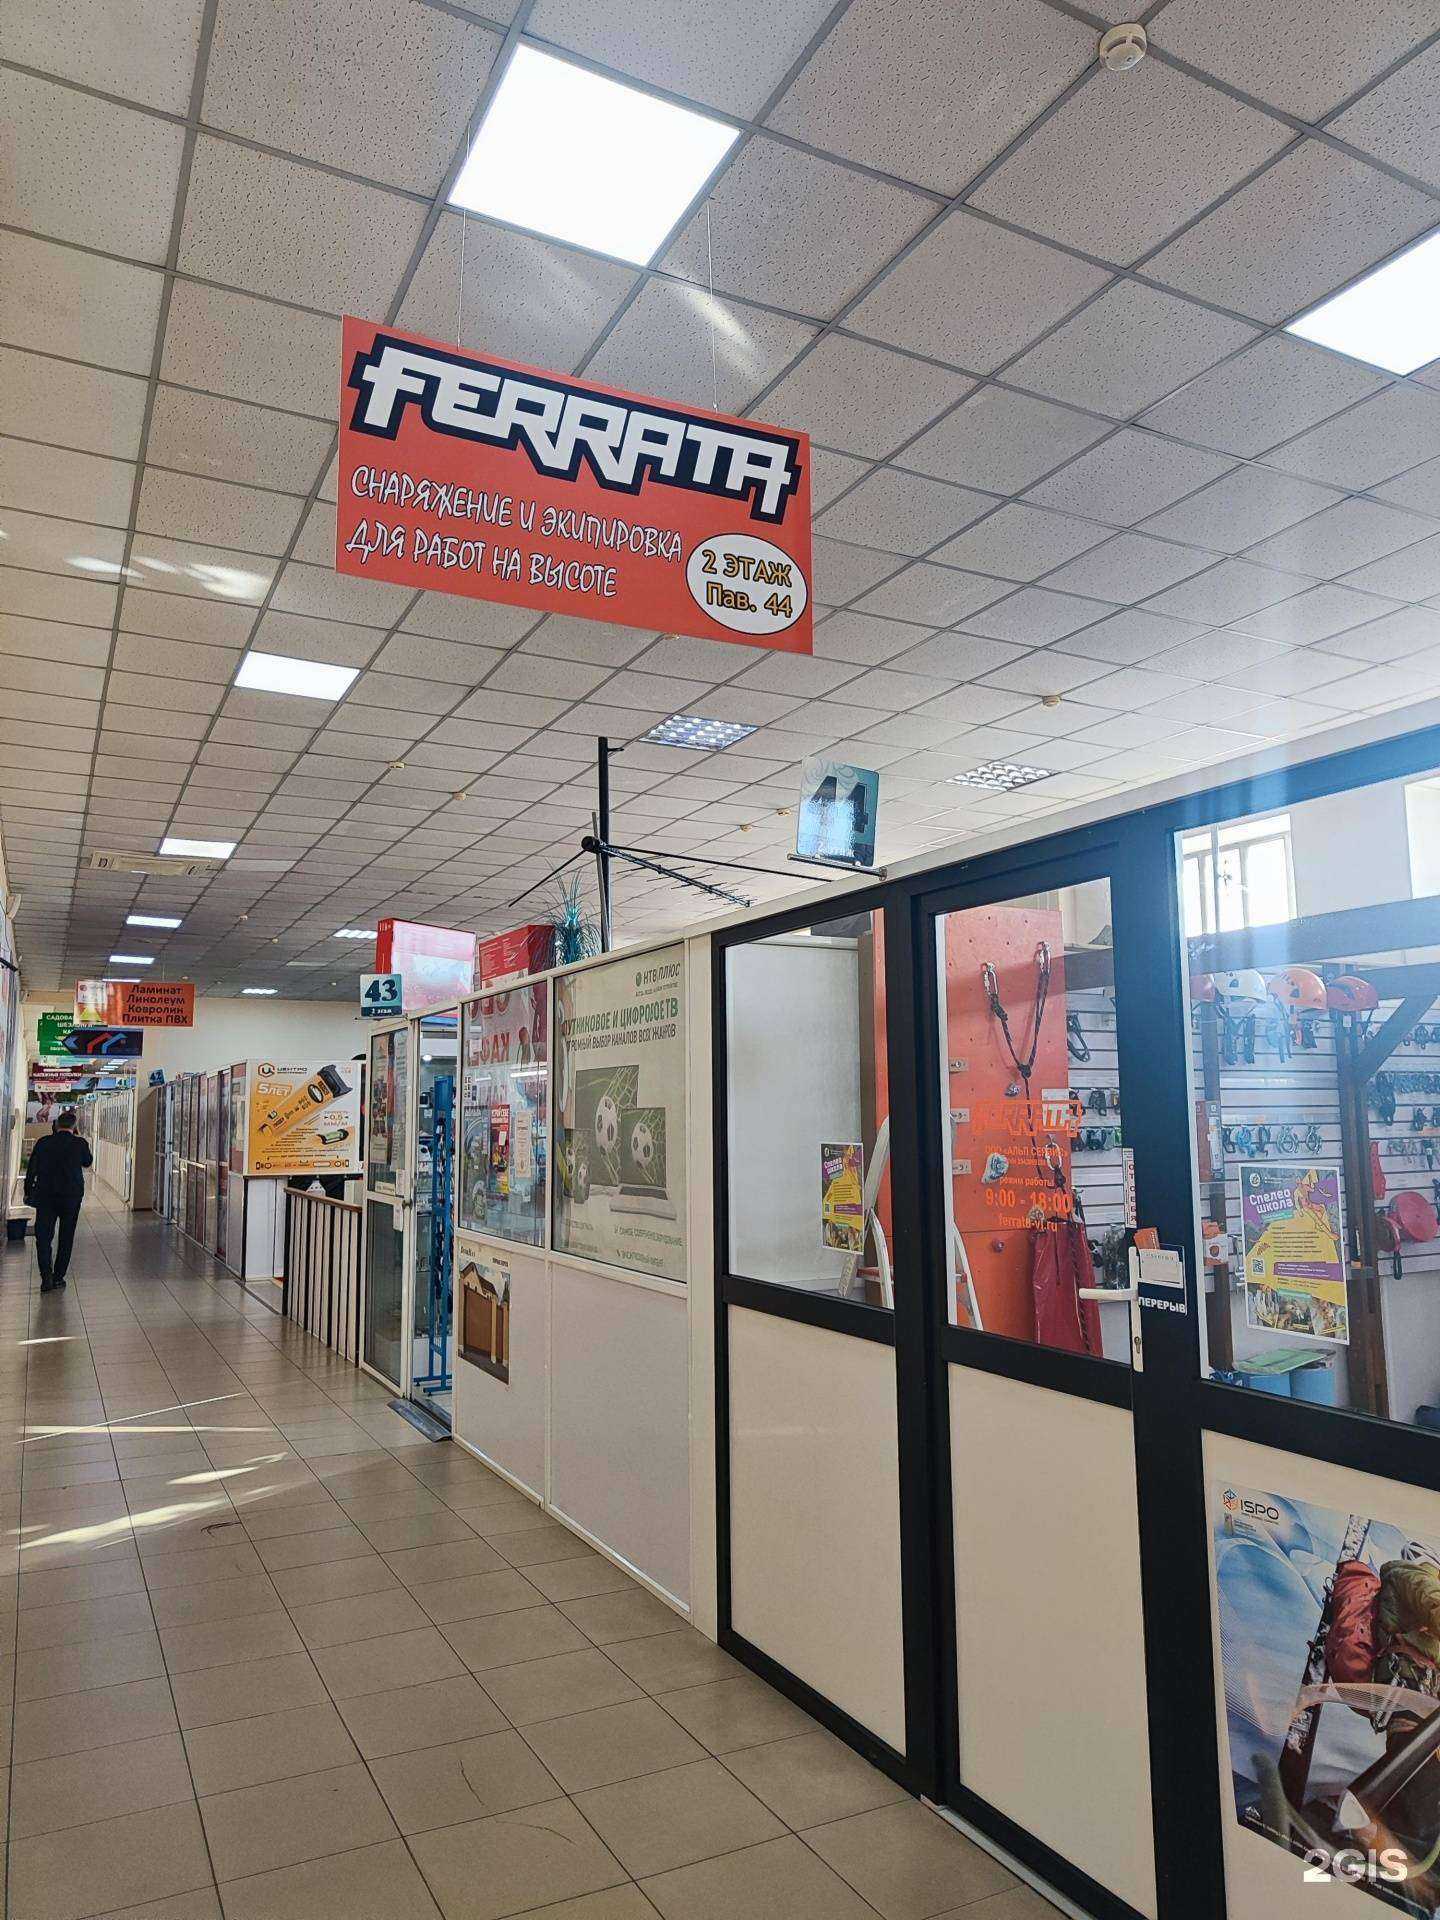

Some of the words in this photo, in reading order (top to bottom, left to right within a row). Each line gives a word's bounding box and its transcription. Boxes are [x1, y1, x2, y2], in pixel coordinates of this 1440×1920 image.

[349, 335, 801, 524] FERRATA
[351, 465, 513, 528] СНАРЯЖЕНИЕ
[519, 502, 534, 532] И
[543, 506, 683, 562] ЭКИПИРОВКА
[345, 519, 406, 564] ДЛЯ
[413, 531, 484, 575] РАБОТ
[492, 547, 522, 582] НА
[528, 551, 618, 598] ВЫСОТЕ
[702, 549, 718, 574] 2
[723, 551, 793, 588] ЭТАЖ
[705, 582, 758, 613] Пав.
[764, 594, 793, 619] 44
[126, 994, 185, 1005] Линолеум
[131, 985, 184, 995] Ламинат
[364, 979, 398, 1002] 43
[122, 1013, 162, 1024] Плитка
[165, 1013, 188, 1024] ПВХ
[127, 1004, 184, 1014] Ковролин
[985, 1188, 1016, 1208] 9:00
[1029, 1190, 1073, 1214] 18:00
[1249, 1188, 1291, 1206] Спелео
[1256, 1199, 1294, 1214] школа
[1138, 1296, 1187, 1314] ПЕРЕРЫВ
[1240, 1499, 1280, 1520] ISPO
